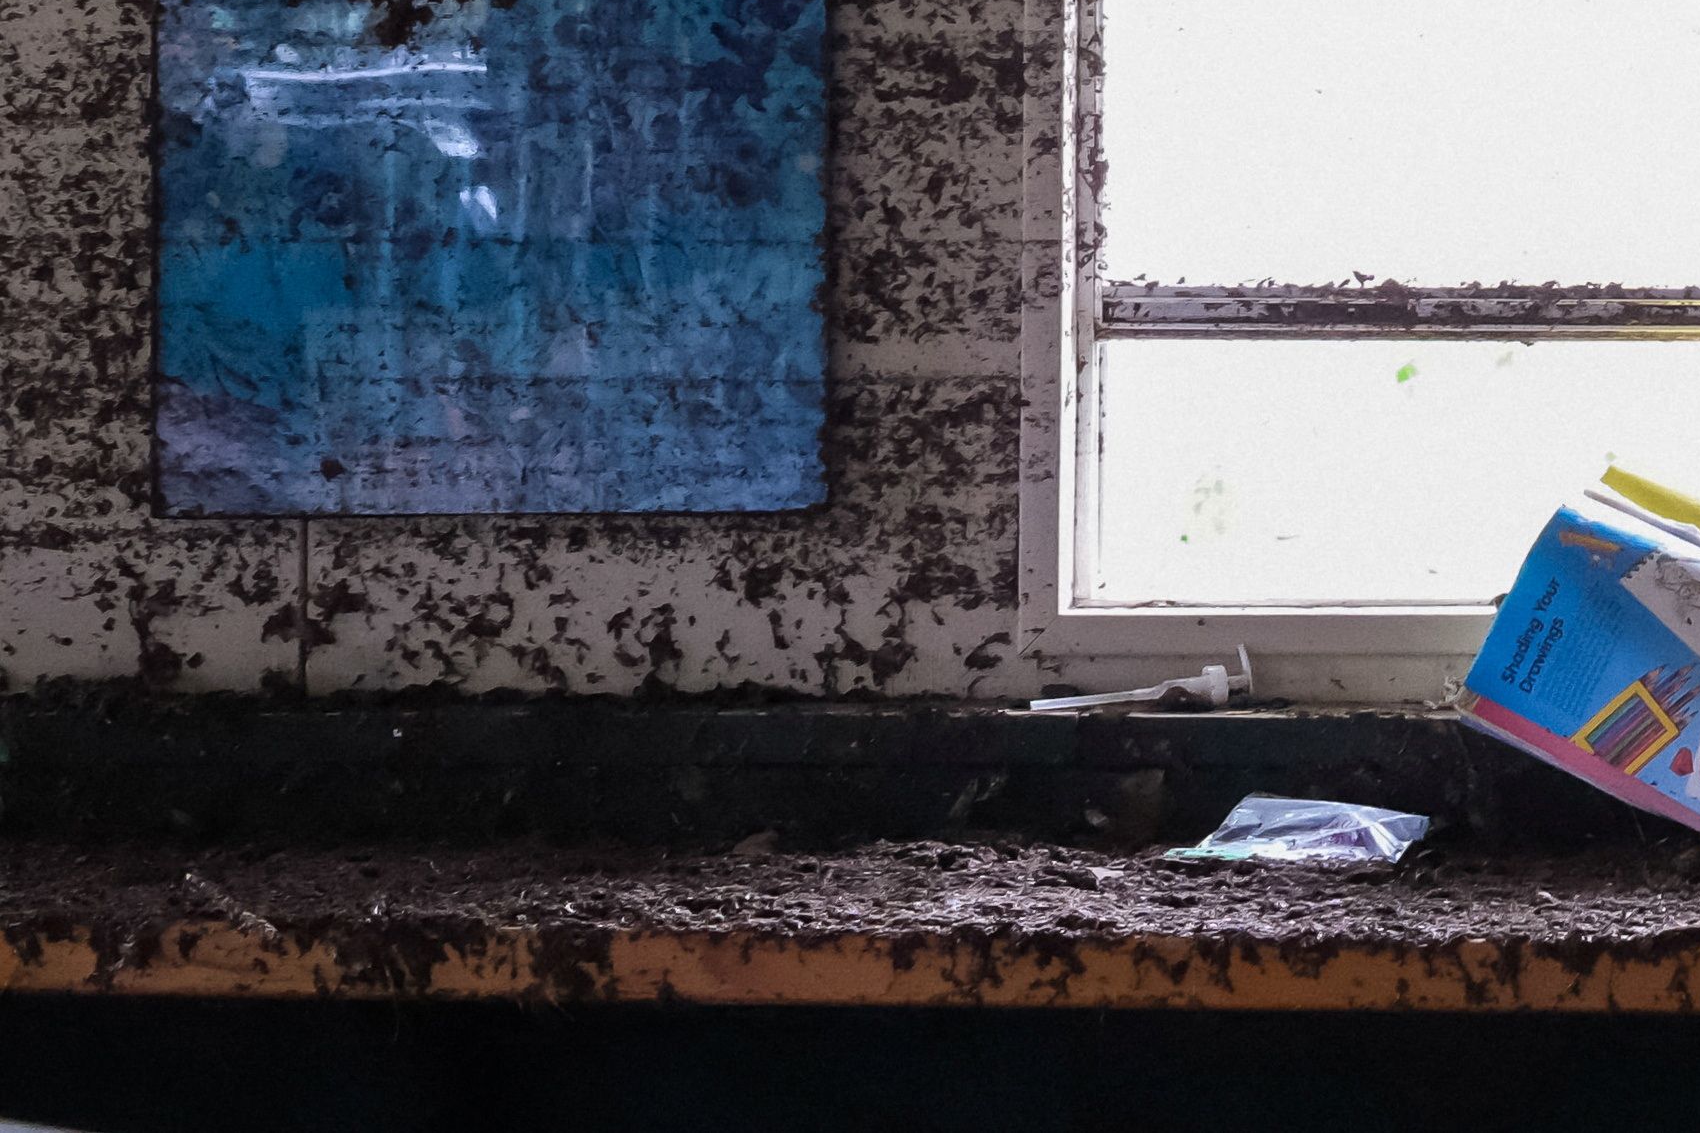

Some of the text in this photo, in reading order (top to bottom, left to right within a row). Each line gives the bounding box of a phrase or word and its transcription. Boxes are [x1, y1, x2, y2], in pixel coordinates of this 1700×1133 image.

[1501, 577, 1560, 684] Shading Your
[1519, 617, 1564, 693] Drawings
